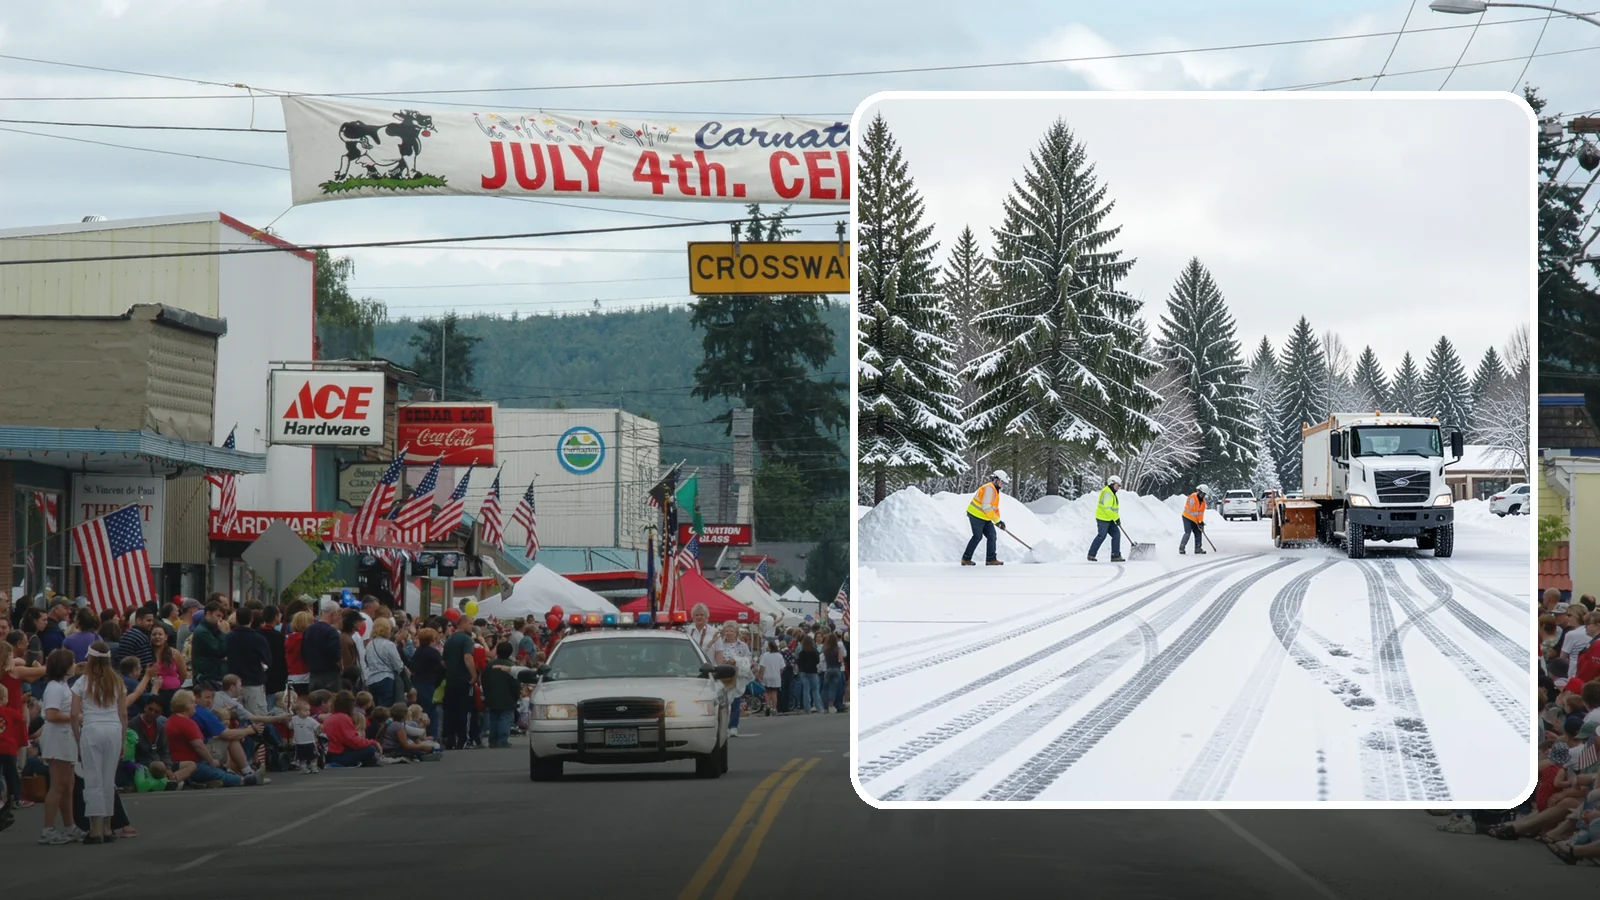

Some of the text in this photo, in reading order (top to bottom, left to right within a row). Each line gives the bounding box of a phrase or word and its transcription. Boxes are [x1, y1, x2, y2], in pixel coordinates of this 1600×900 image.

[481, 141, 604, 193] JULY
[633, 150, 746, 198] 4th.
[697, 254, 850, 280] CROSSWA
[283, 380, 373, 420] ACE
[405, 409, 485, 421] CEDAR LOG
[283, 421, 371, 436] Hardware
[416, 428, 477, 447] Coca-Cola
[353, 467, 386, 479] Simpl
[96, 485, 124, 495] Vincent
[126, 486, 136, 495] de
[138, 486, 155, 495] Paul
[688, 526, 741, 535] CRNATION
[699, 535, 730, 543] GLASS
